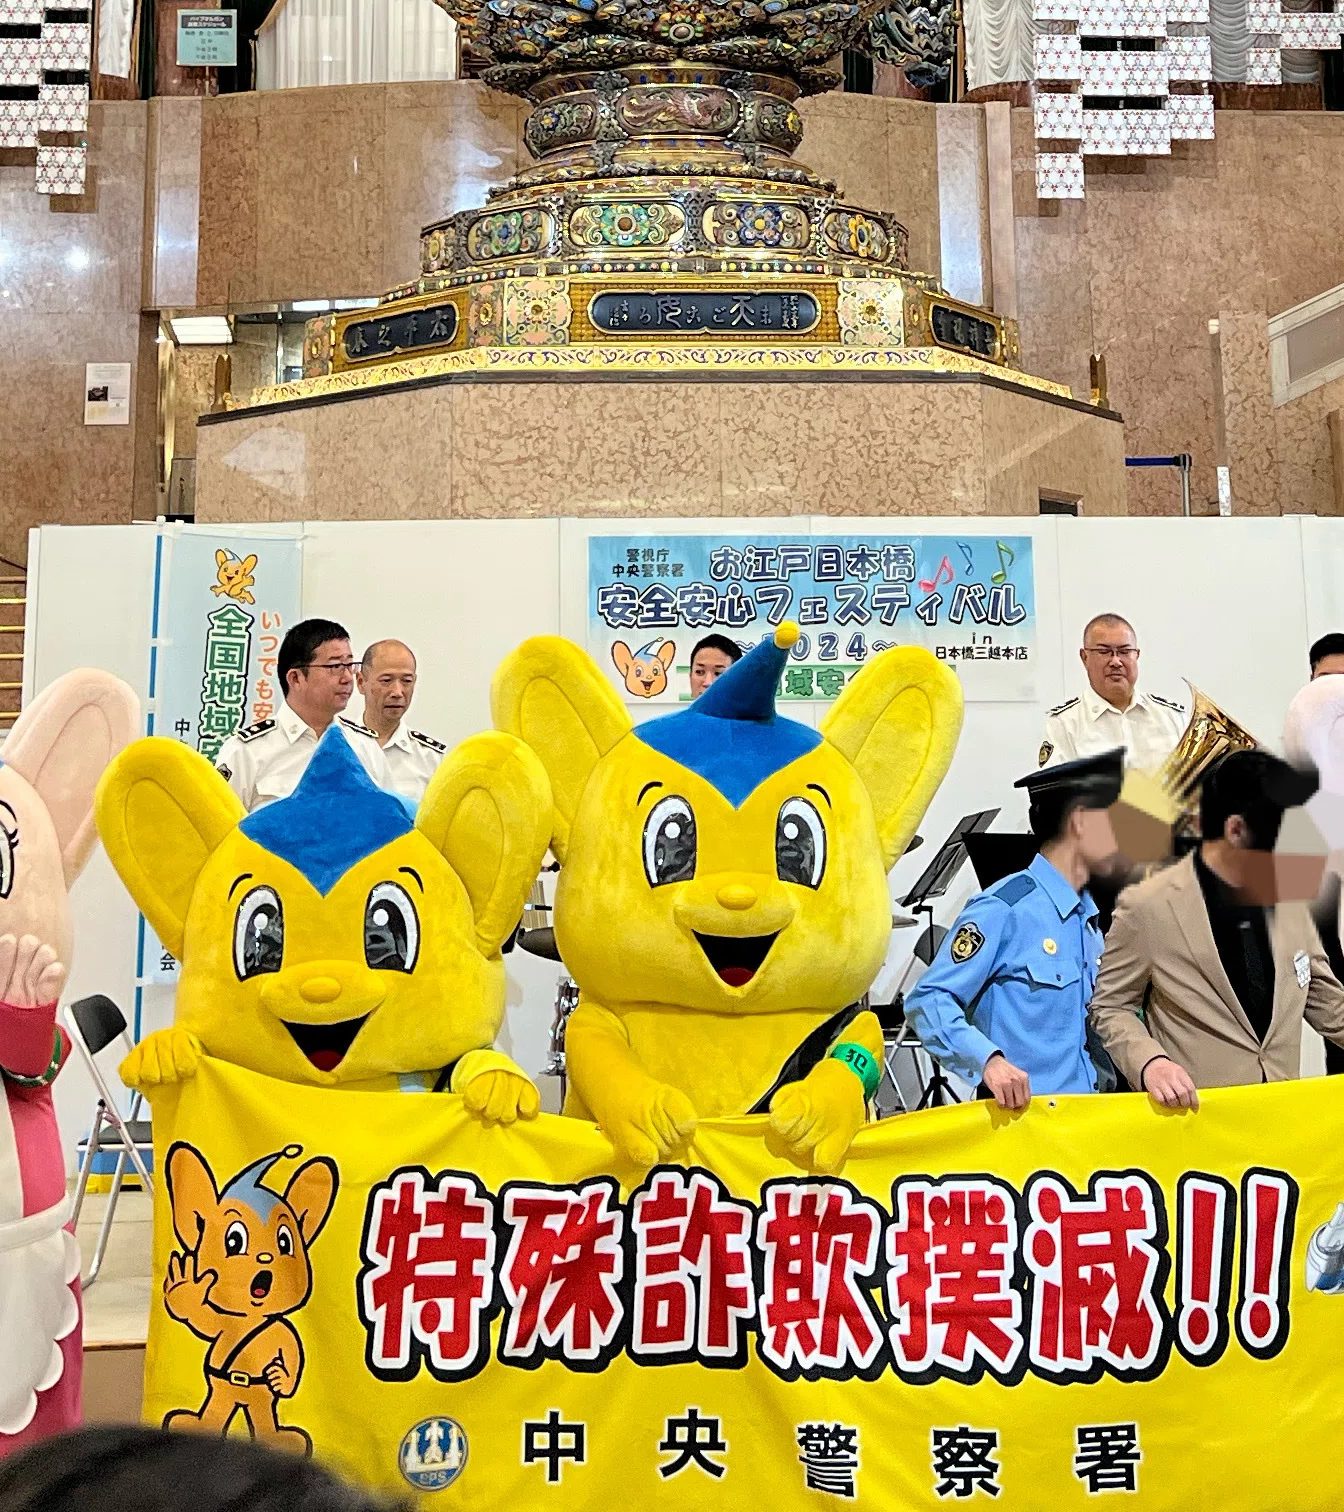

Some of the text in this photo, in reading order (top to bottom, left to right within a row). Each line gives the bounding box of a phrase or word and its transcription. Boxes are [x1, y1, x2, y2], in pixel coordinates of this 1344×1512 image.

[626, 548, 670, 562] 警視庁
[710, 545, 916, 581] お江戸日本橋
[612, 564, 684, 577] 中央警察署
[597, 582, 1028, 629] 安全安心フェスティバル
[972, 632, 993, 644] in
[936, 646, 1028, 661] 日本橋三越本店
[363, 1172, 1290, 1377] 特殊詐欺撲滅!!
[523, 1408, 1141, 1496] 中央警察署
